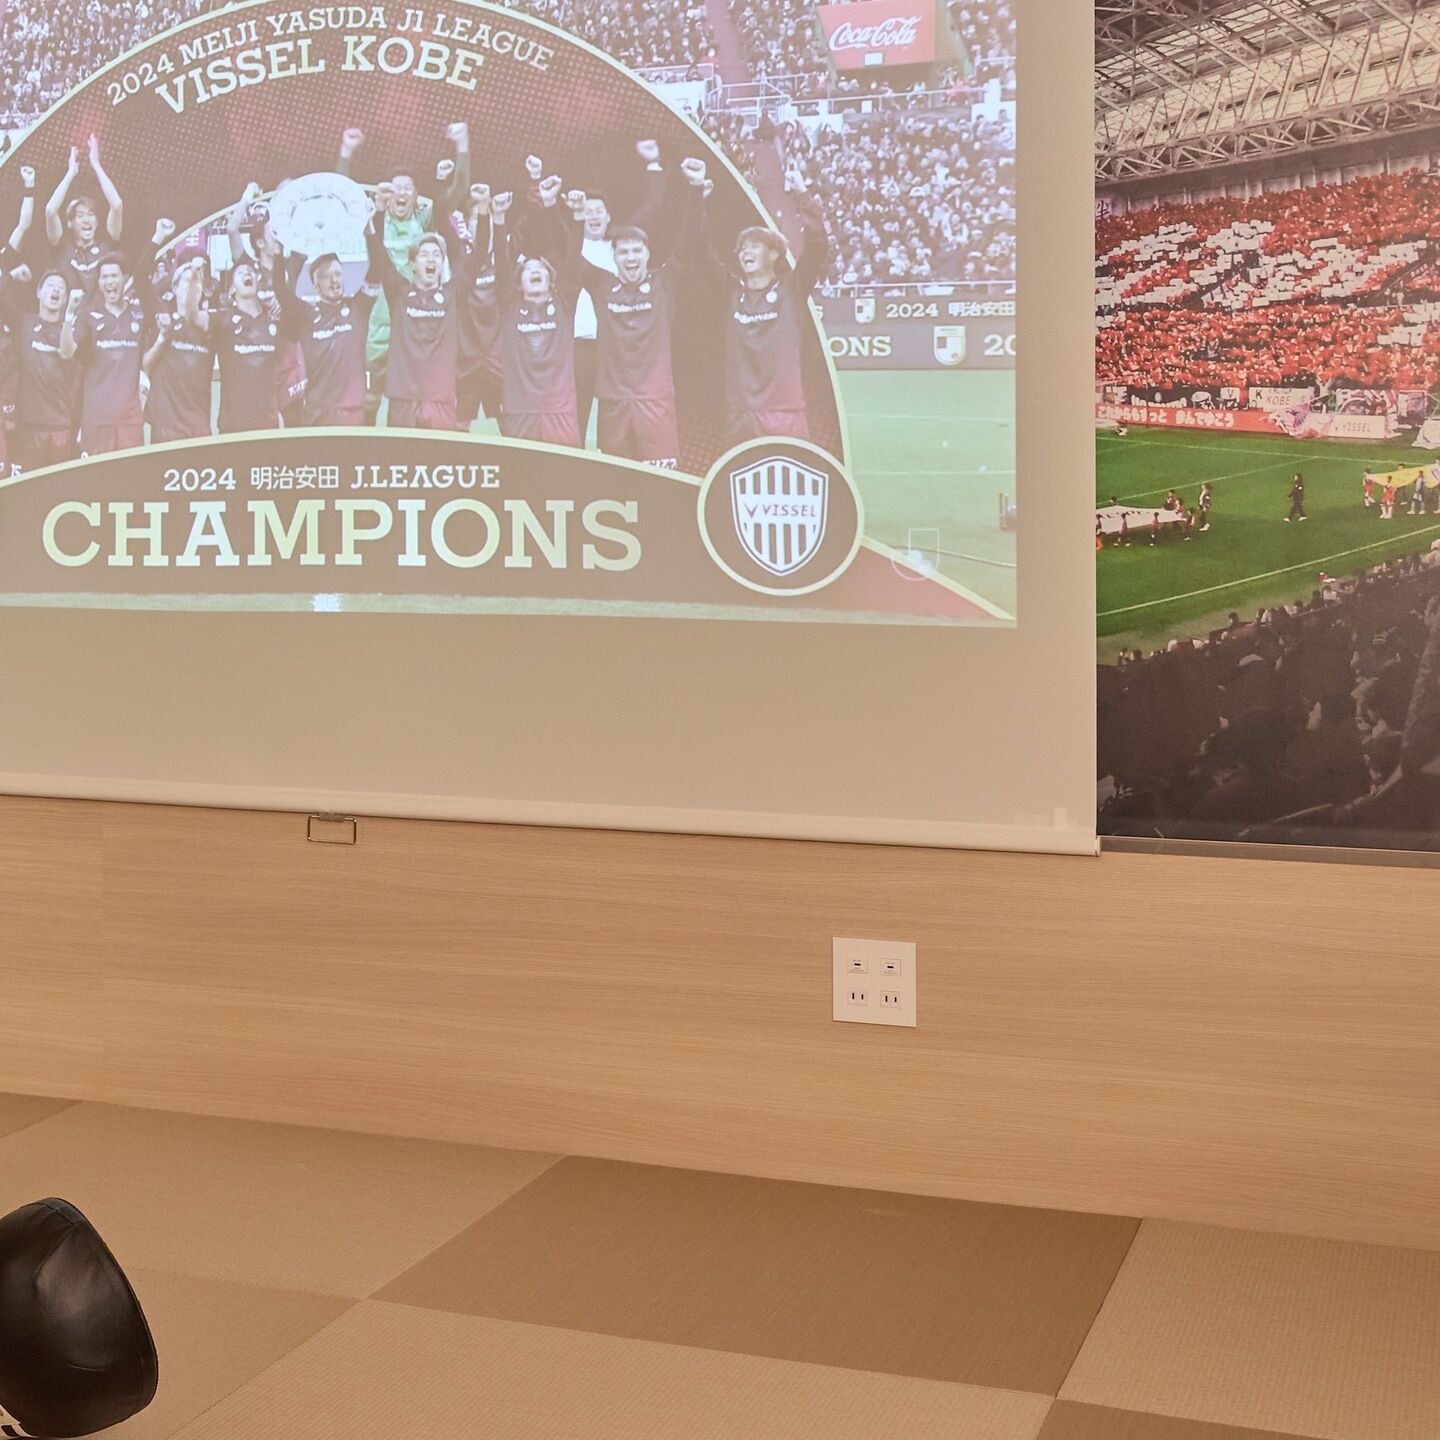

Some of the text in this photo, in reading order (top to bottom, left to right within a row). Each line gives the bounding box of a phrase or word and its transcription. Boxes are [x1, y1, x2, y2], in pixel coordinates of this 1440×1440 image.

[107, 7, 555, 105] 2024 MEIJI YASUDA J1 LEAGUE
[155, 35, 484, 114] VISSEL KOBE
[886, 303, 939, 318] 2024
[164, 465, 500, 491] 2024 明治安田 J.LEAGUE
[761, 503, 817, 517] VISSEL
[42, 499, 642, 572] CHAMPIONS
